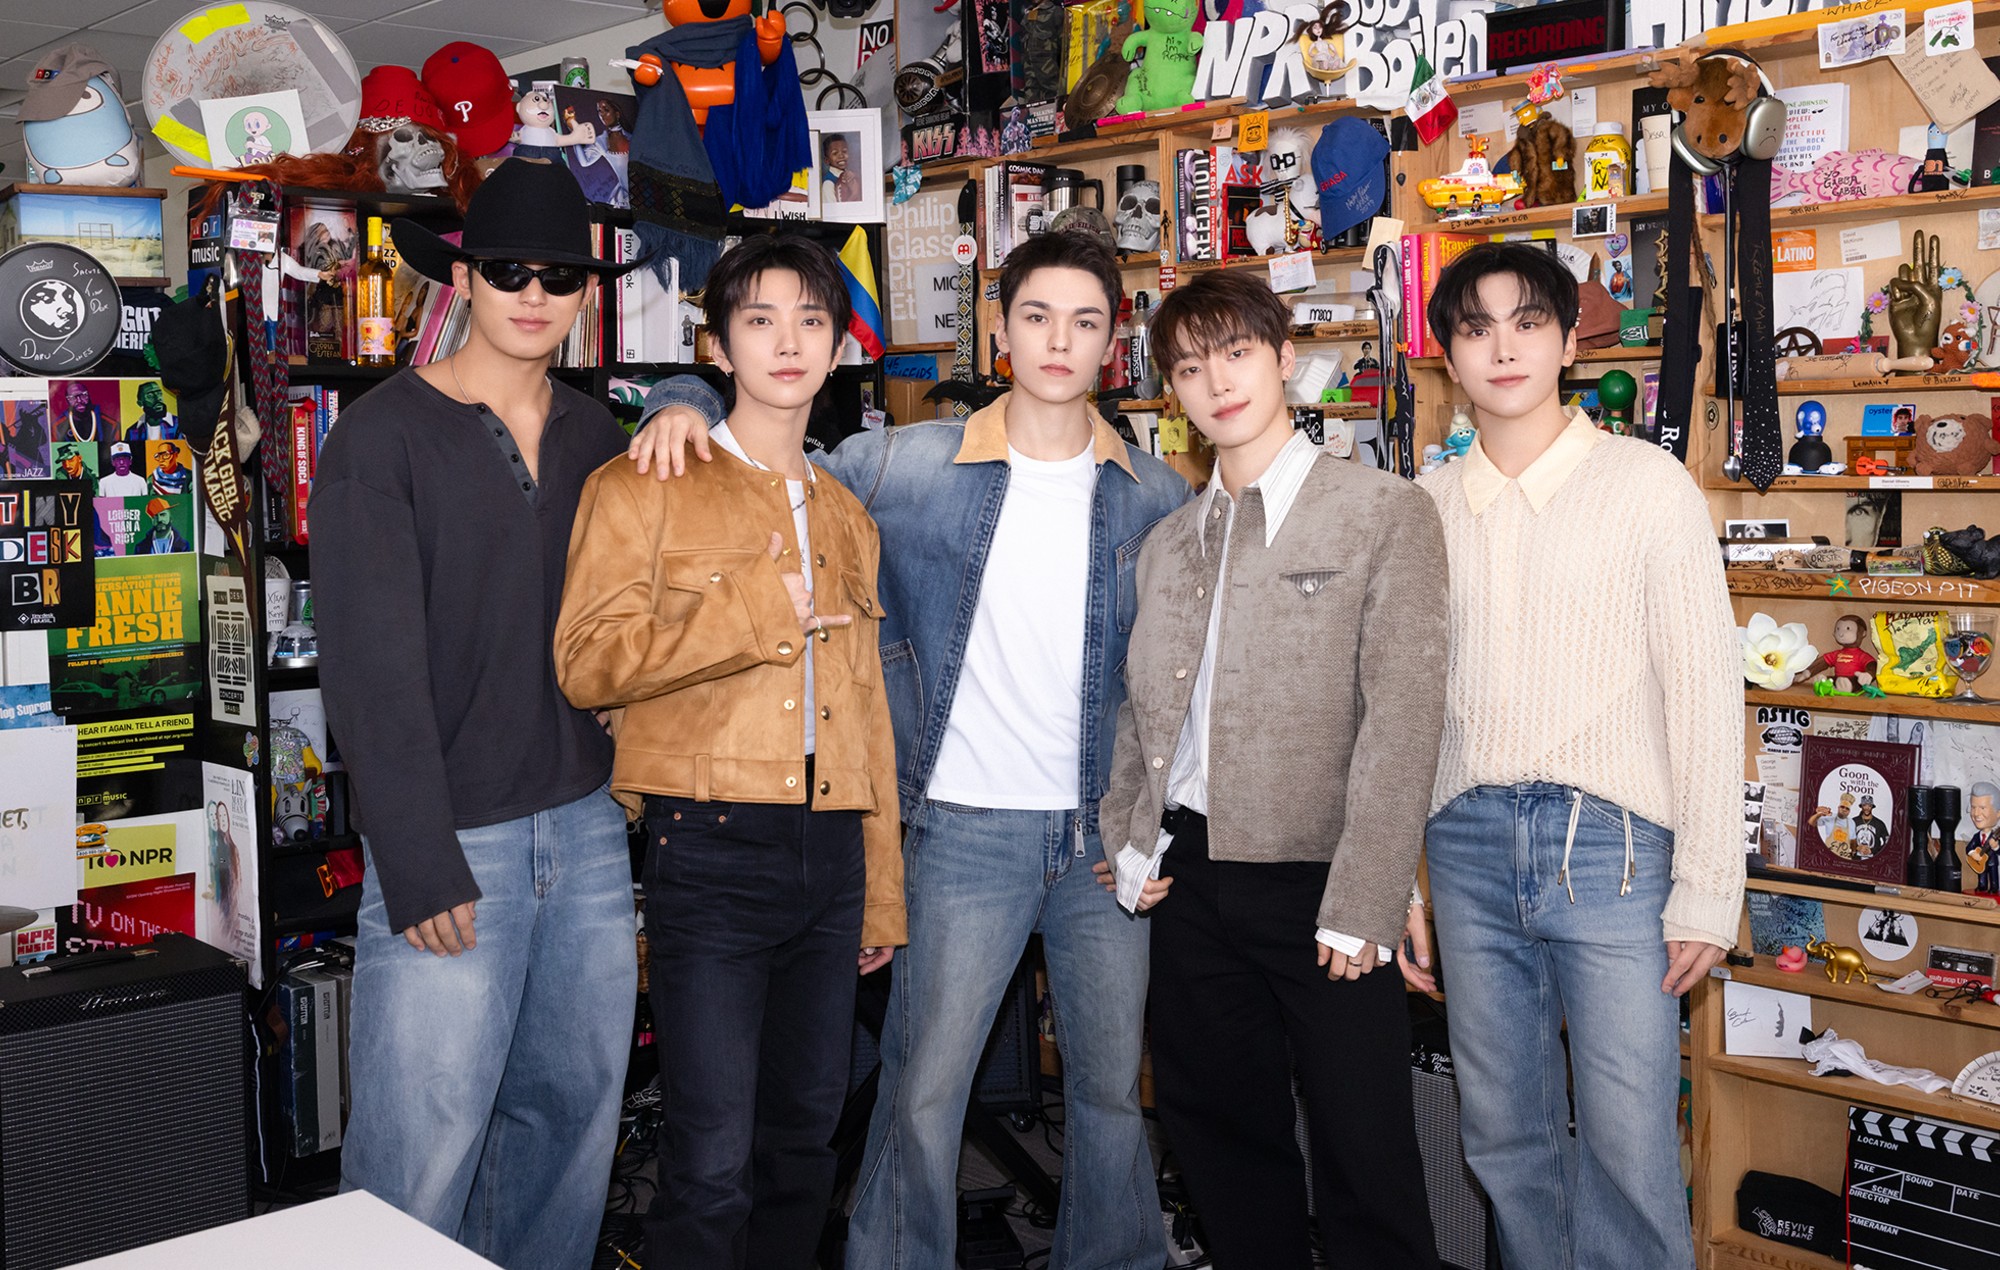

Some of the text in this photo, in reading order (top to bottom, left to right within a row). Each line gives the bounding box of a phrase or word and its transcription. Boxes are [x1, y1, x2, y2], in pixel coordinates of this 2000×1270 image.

[862, 27, 889, 49] NO
[1489, 16, 1605, 60] RECORDING
[1345, 0, 1487, 98] Boilen
[1643, 104, 1656, 113] MY
[1798, 99, 1828, 107] JOHNSON
[454, 101, 473, 122] P
[913, 123, 955, 160] KISS
[1785, 129, 1825, 138] SPECTIVE
[1009, 165, 1032, 174] COSMIC
[1225, 164, 1263, 185] ASK
[1824, 176, 1861, 189] GABBA
[781, 212, 806, 221] WISH
[887, 197, 955, 234] Philip
[193, 220, 218, 236] npr
[236, 219, 273, 231] PHILCORP
[1196, 206, 1210, 260] REED
[1635, 224, 1645, 232] JAY
[192, 242, 220, 263] music
[888, 232, 956, 261] Glass
[1777, 246, 1815, 262] LATINO
[625, 234, 634, 289] tiny Bok
[891, 292, 917, 320] Et
[1310, 309, 1333, 322] moog
[1869, 407, 1892, 417] oyster
[296, 427, 306, 451] KING
[22, 467, 43, 477] JAZZ
[297, 459, 307, 485] SOCA
[203, 463, 232, 522] MAGIC
[218, 463, 240, 511] GIRL
[0, 490, 82, 527] TINY
[108, 509, 140, 522] LOUDER
[109, 522, 140, 533] THAN A
[0, 527, 82, 566] DESK
[115, 533, 135, 545] RIOT
[11, 569, 61, 606] BR
[155, 577, 181, 587] WITH
[1859, 578, 1978, 598] PIGEON PIT
[96, 587, 182, 616] ANNIE
[67, 610, 184, 649] FRESH
[220, 689, 244, 701] CONCERTS
[1758, 708, 1810, 728] ASTIG
[78, 727, 99, 736] HEAR
[109, 723, 134, 732] AGAIN.
[135, 721, 154, 730] TELL
[161, 718, 191, 727] FRIEND.
[1839, 768, 1869, 780] Goon
[1840, 781, 1874, 795] Spoon
[78, 797, 100, 805] npr
[130, 848, 172, 866] NPR
[72, 900, 161, 938] TV ON THE
[17, 929, 55, 943] NPR
[1943, 975, 1956, 984] pop
[1857, 1135, 1899, 1151] LOCATION
[1854, 1162, 1875, 1173] TAKE
[1905, 1174, 1934, 1188] SOUND
[1849, 1189, 1890, 1205] DIRECTOR
[1872, 1185, 1899, 1198] SCENE
[1956, 1188, 1980, 1200] DATE
[1777, 1219, 1815, 1235] REVIVE
[1848, 1216, 1899, 1235] CAMERAMAN
[1777, 1228, 1813, 1241] BIG BAND
